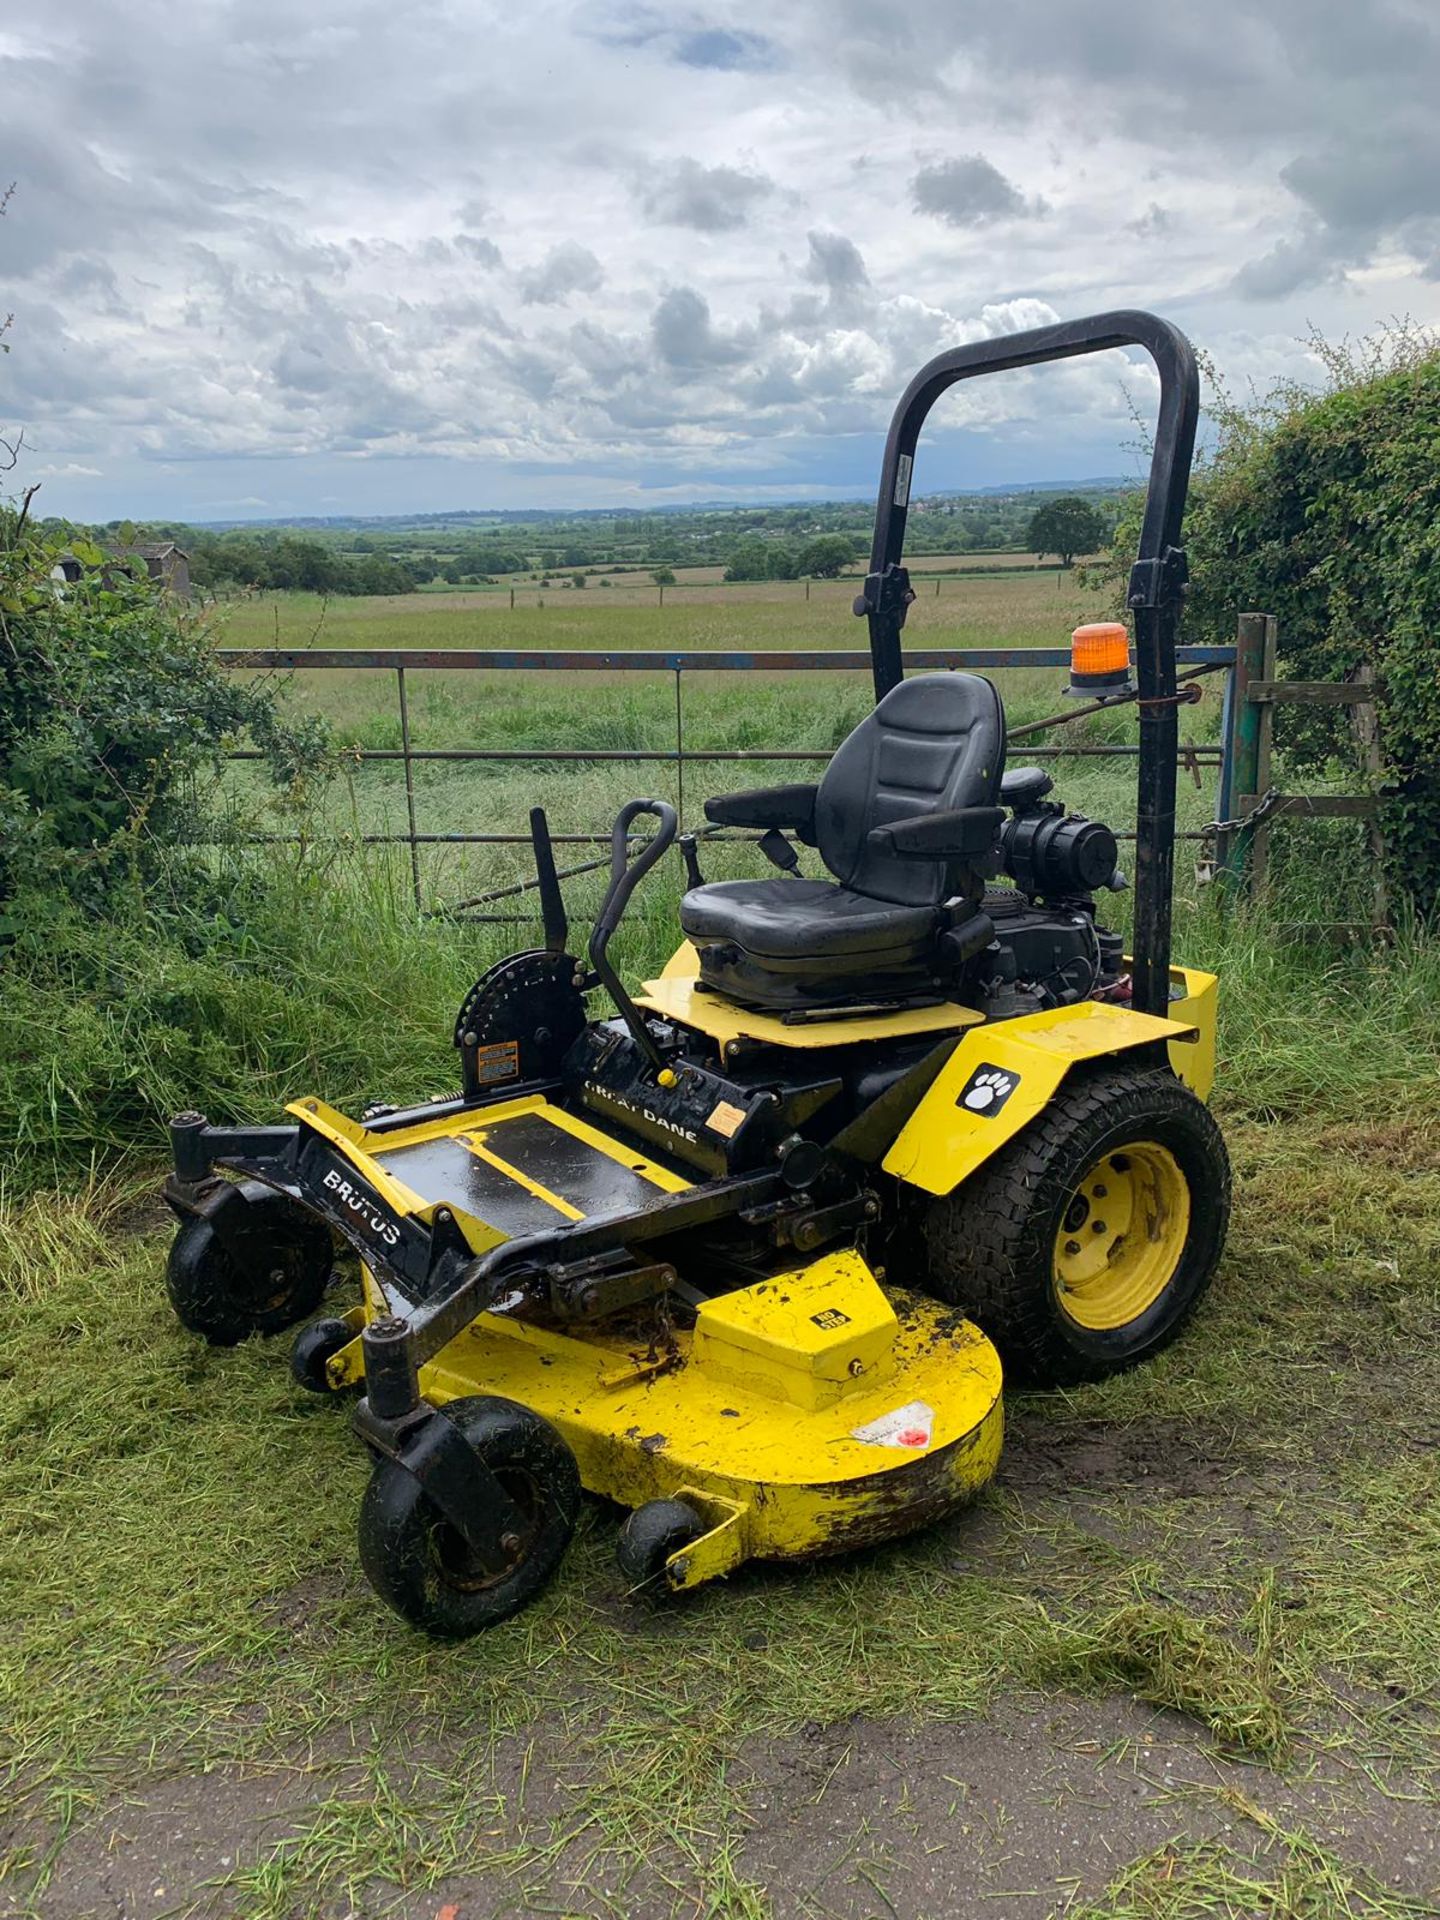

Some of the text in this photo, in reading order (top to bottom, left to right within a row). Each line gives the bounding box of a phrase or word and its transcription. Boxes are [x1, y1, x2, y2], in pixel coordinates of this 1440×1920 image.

[643, 1108, 697, 1144] DANE
[323, 1169, 401, 1245] BRUTUS
[815, 1311, 835, 1322] NO
[820, 1315, 846, 1329] STEP
